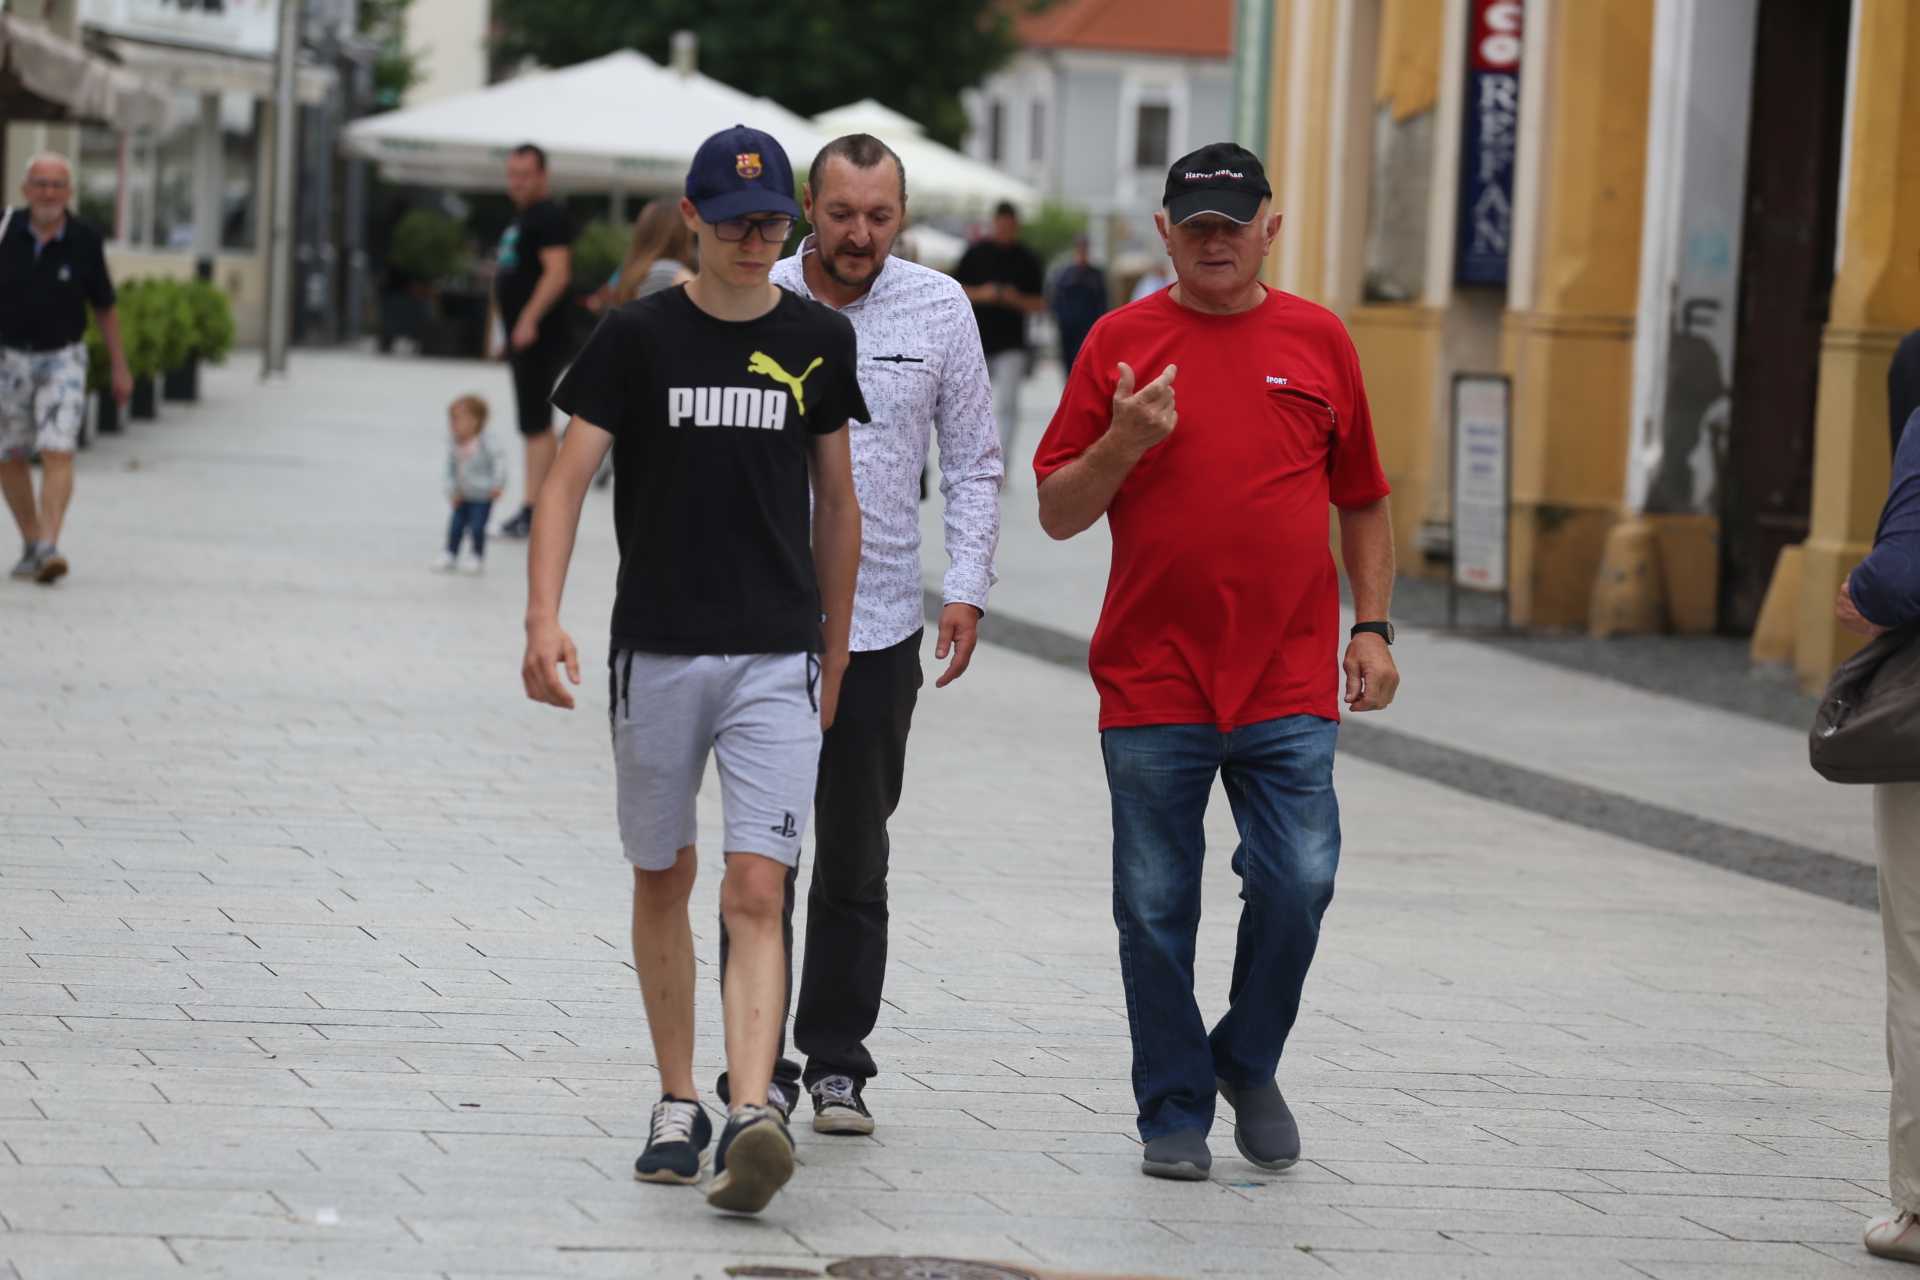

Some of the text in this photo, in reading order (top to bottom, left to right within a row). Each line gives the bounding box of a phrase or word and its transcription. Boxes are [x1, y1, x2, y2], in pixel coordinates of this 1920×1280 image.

[1215, 169, 1243, 178] Norman
[1474, 74, 1517, 253] REFAN
[1266, 375, 1288, 385] SPORT
[668, 387, 787, 430] PUMA
